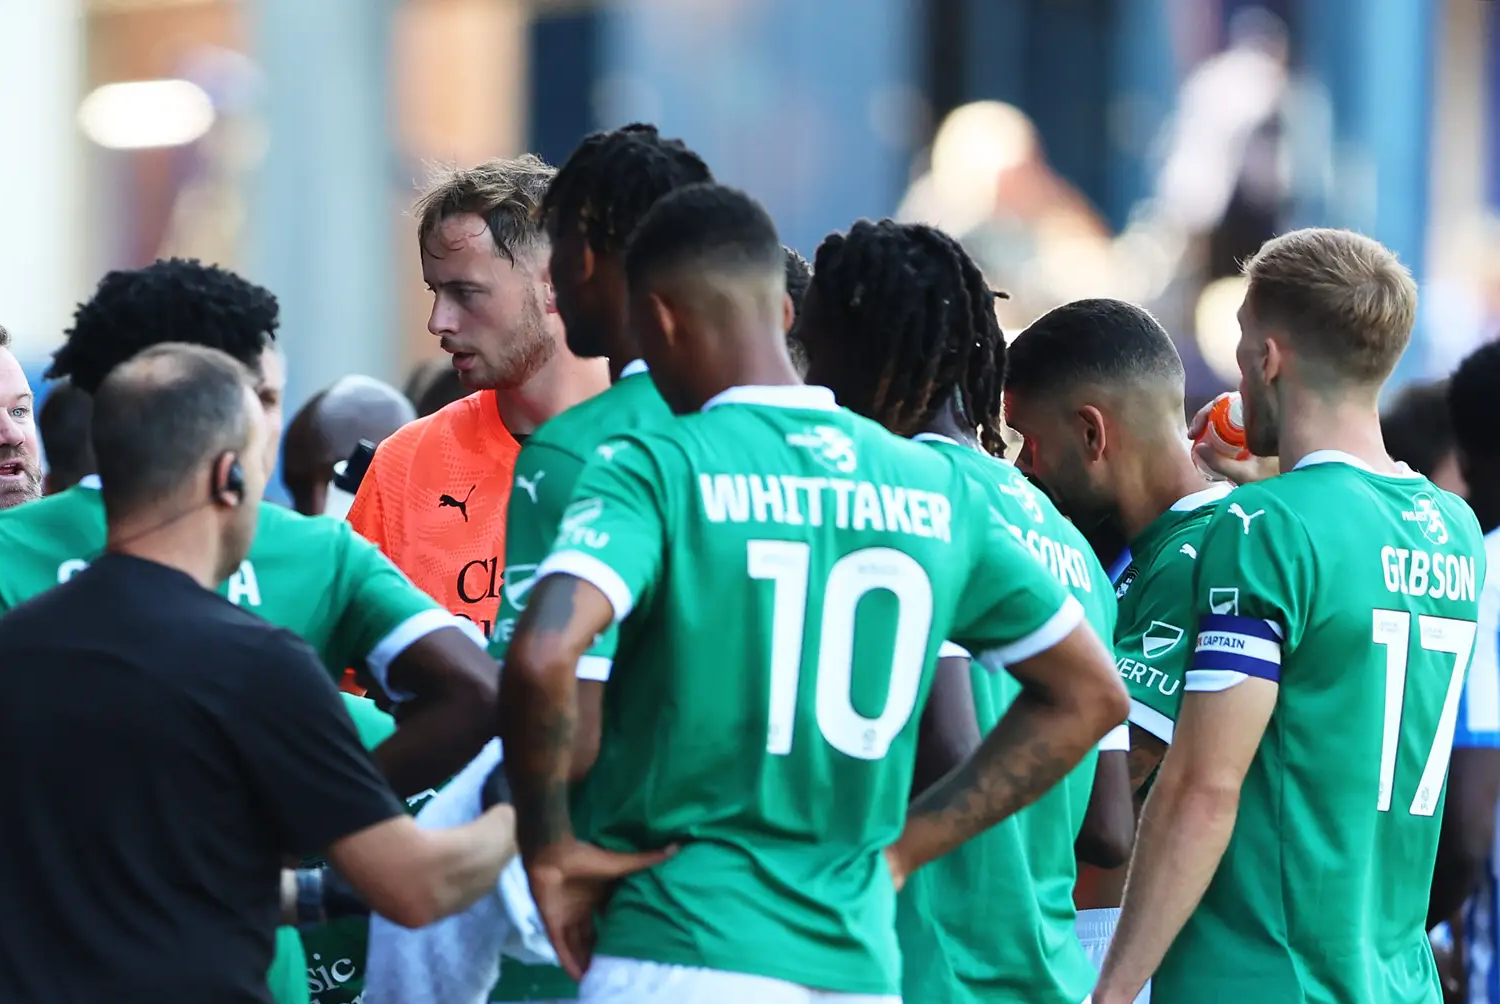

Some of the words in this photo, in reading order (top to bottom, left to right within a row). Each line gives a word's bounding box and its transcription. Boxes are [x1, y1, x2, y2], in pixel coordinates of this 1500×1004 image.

[699, 472, 952, 543] WHITTAKER
[1380, 545, 1476, 603] GIBSON
[746, 538, 934, 760] 10
[1203, 635, 1246, 650] CAPTAIN
[1372, 607, 1478, 817] 17
